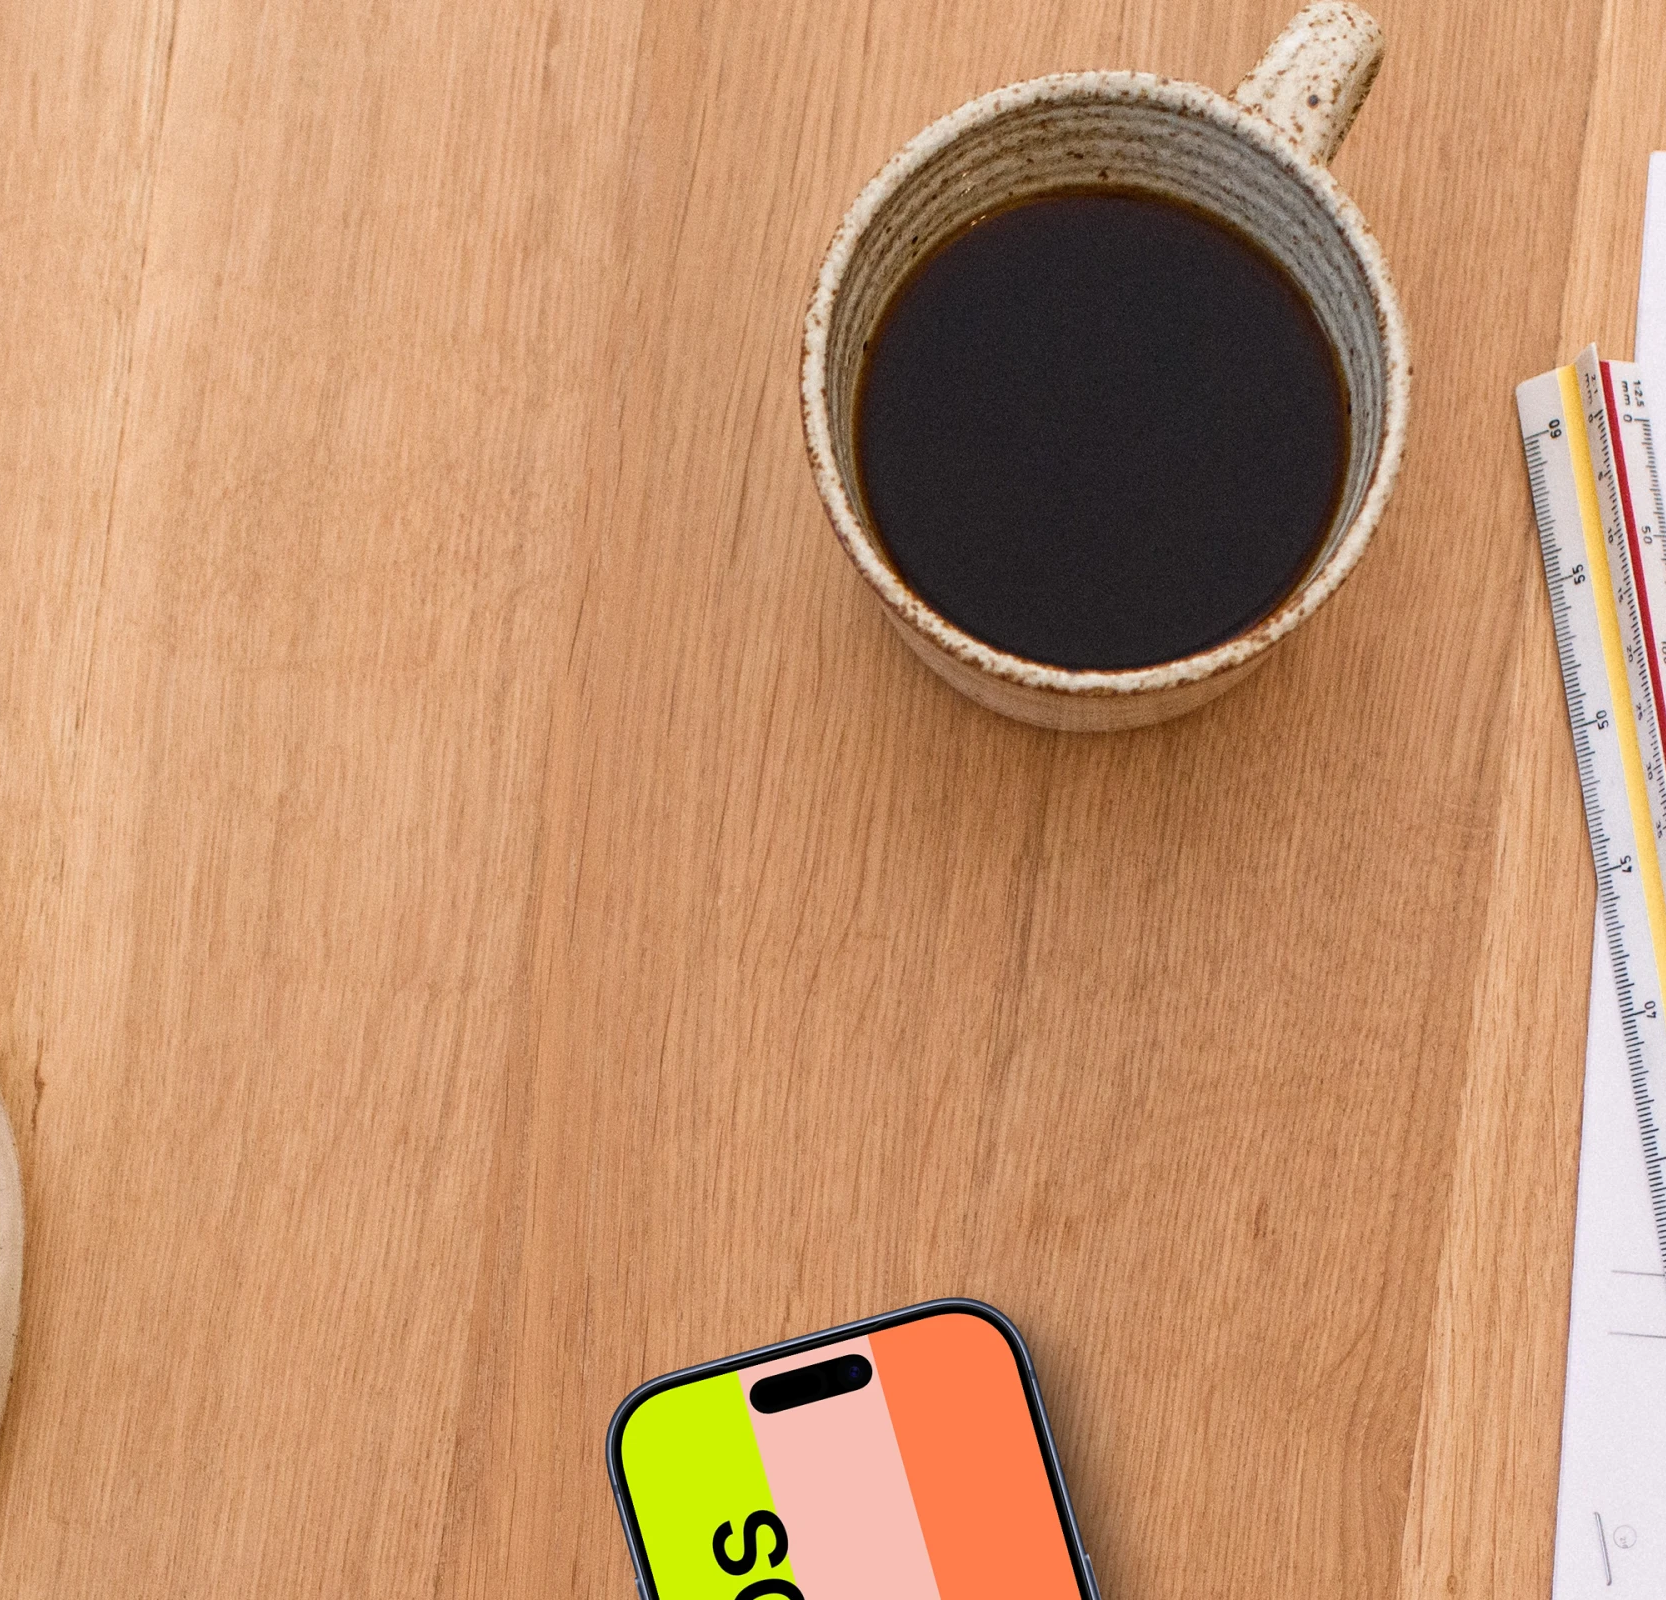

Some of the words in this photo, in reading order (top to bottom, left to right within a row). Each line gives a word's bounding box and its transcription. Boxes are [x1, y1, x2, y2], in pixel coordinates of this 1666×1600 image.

[1622, 380, 1631, 406] mm
[1623, 414, 1632, 423] 0
[1549, 419, 1562, 439] 60
[1642, 525, 1652, 544] 50
[1573, 564, 1585, 585] 55
[1596, 710, 1609, 730] 50
[1620, 855, 1632, 873] 45
[1644, 1000, 1657, 1019] 40
